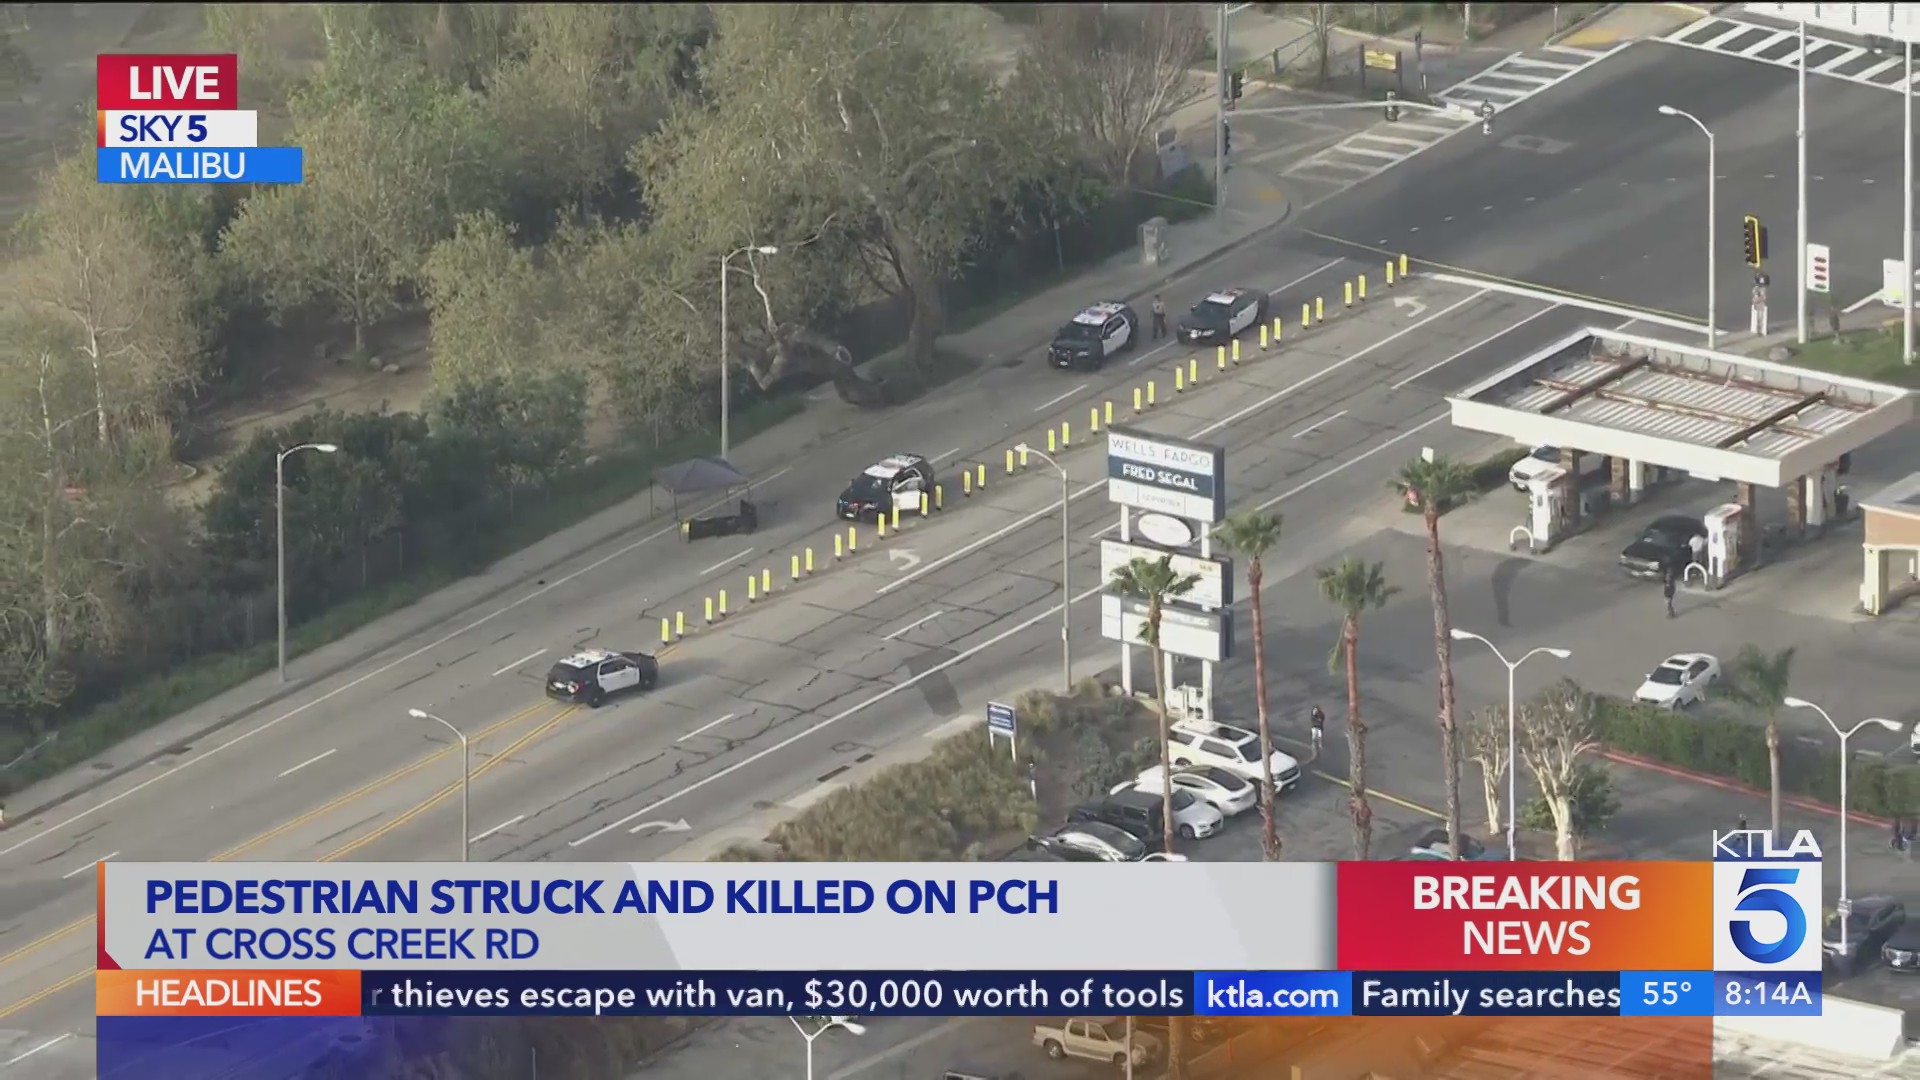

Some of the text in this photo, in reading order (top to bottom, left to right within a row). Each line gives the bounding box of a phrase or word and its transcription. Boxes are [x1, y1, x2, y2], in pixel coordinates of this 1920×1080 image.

[1112, 439, 1210, 468] WELLS FARGO
[1122, 463, 1199, 490] FRED SEGAL
